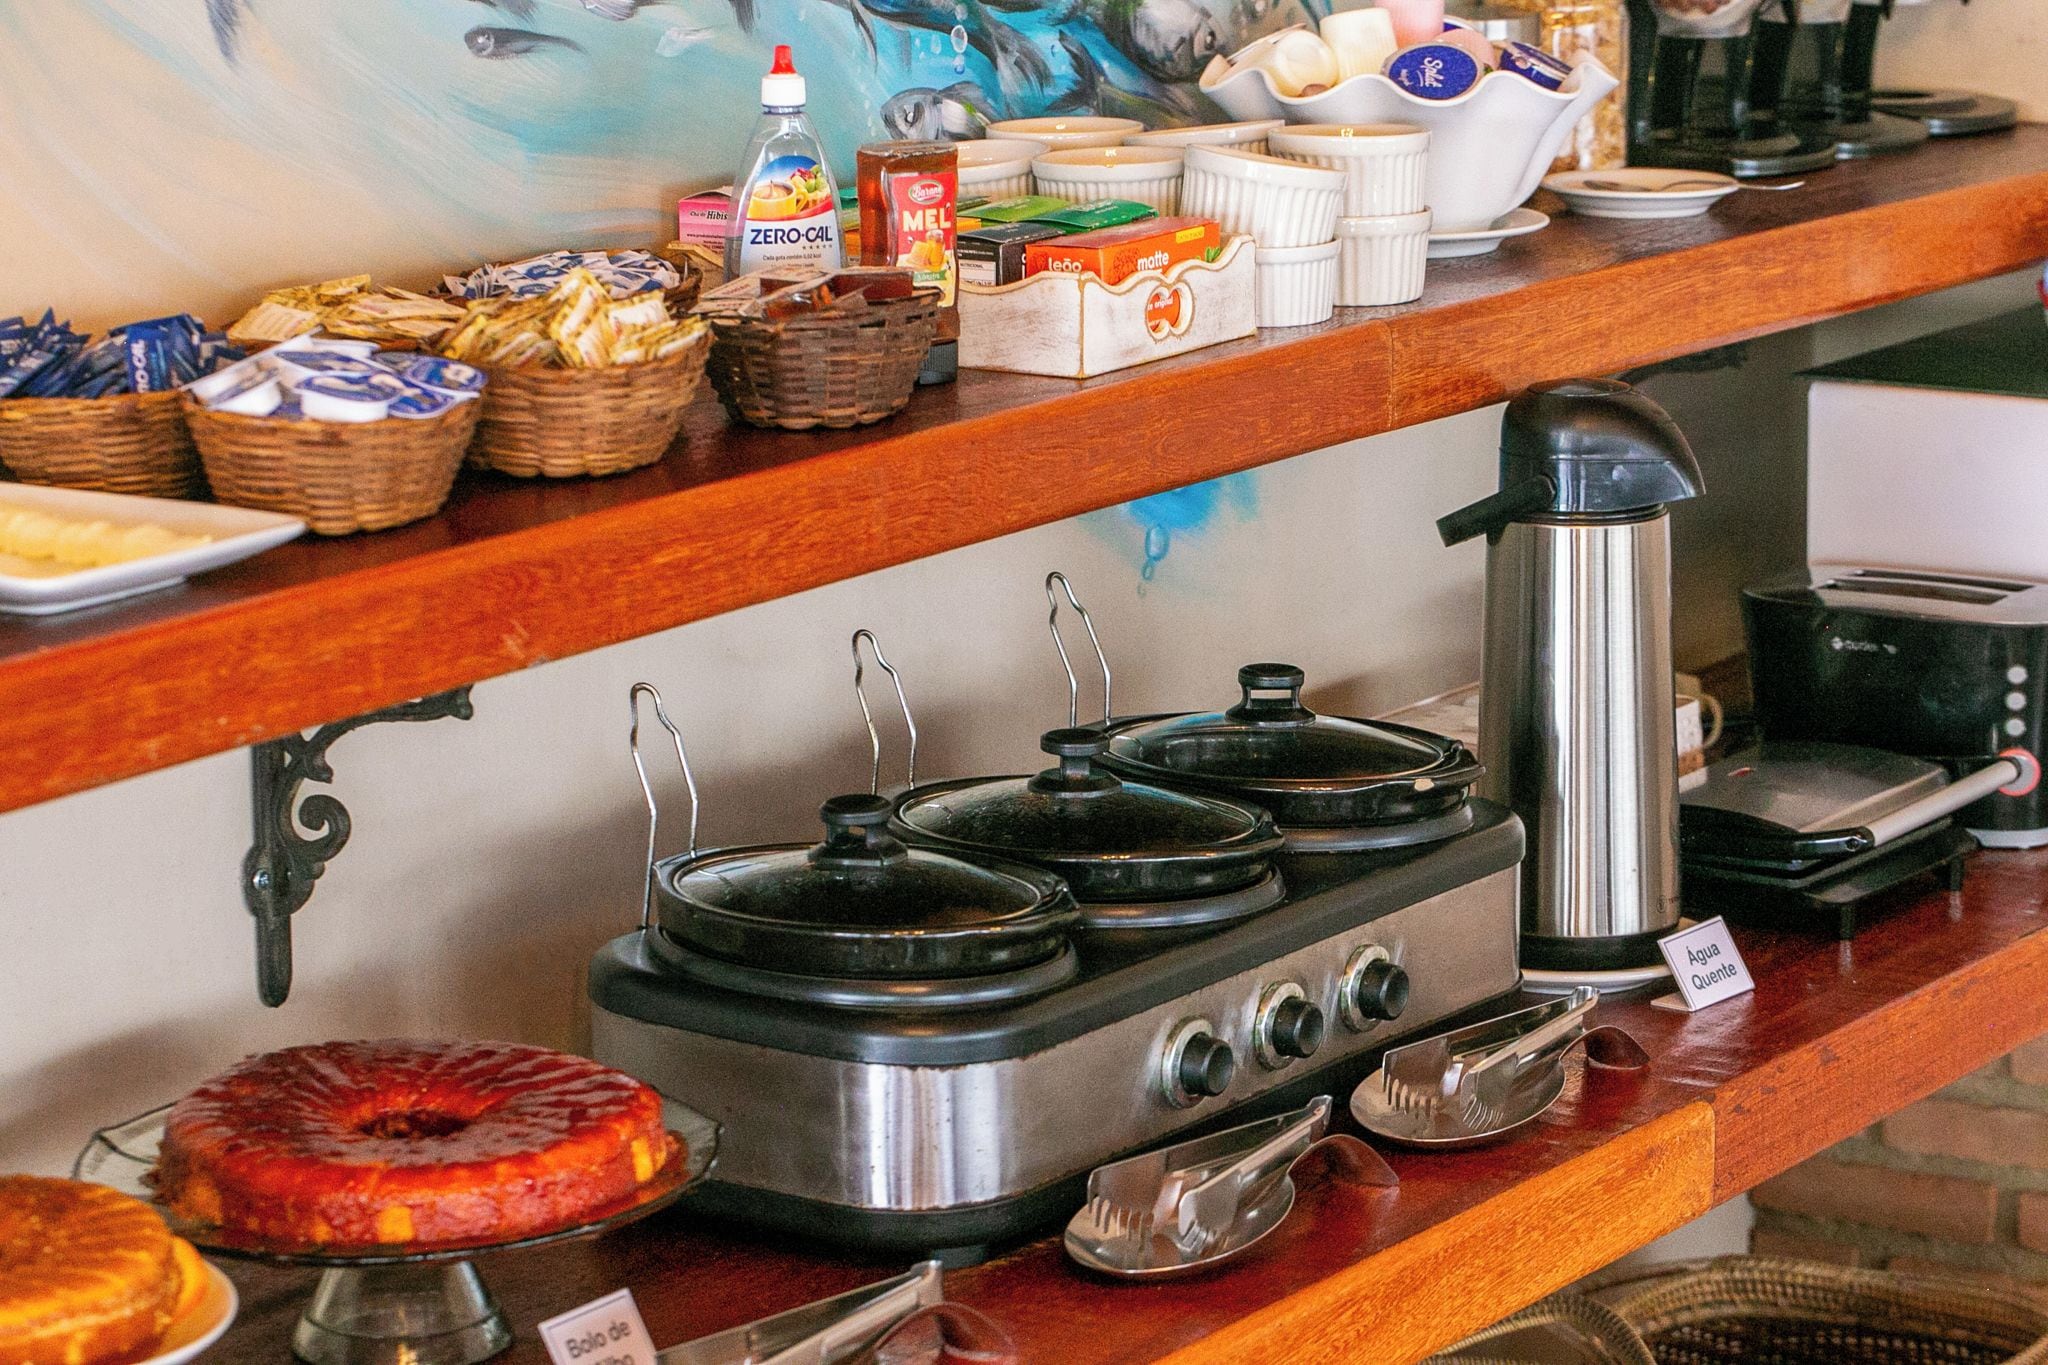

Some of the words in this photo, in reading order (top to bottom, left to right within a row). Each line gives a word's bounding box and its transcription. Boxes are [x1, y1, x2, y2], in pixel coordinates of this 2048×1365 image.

[706, 210, 728, 220] Hibis
[902, 207, 951, 233] MEL
[1048, 257, 1082, 272] leão
[1137, 250, 1169, 271] matte
[1686, 944, 1721, 966] Água
[1691, 963, 1737, 990] Quente
[566, 1332, 607, 1358] Bolo
[608, 1321, 632, 1341] de
